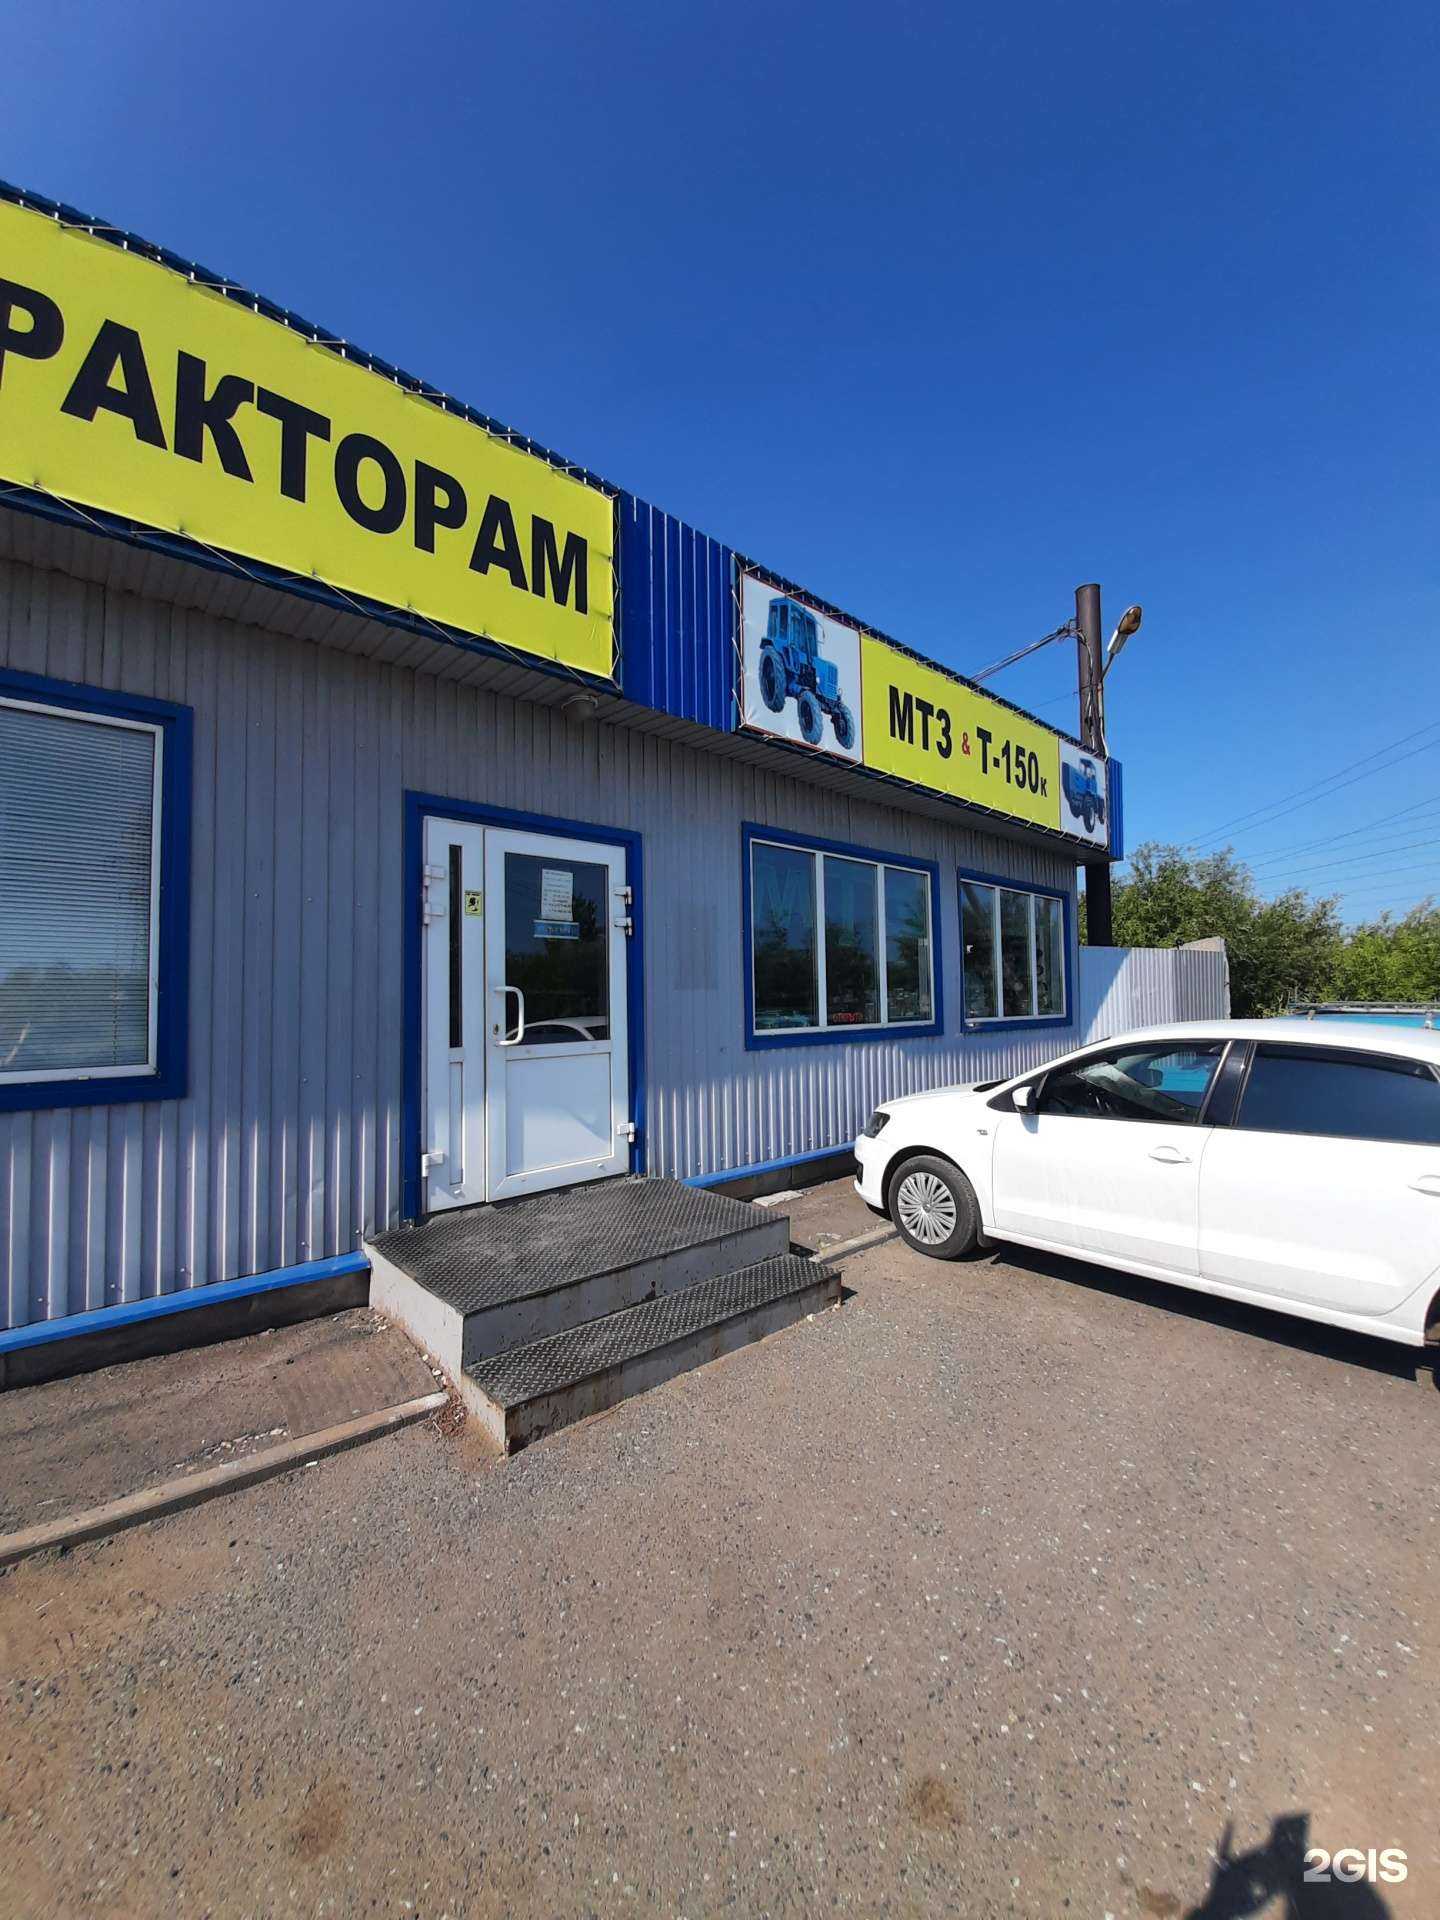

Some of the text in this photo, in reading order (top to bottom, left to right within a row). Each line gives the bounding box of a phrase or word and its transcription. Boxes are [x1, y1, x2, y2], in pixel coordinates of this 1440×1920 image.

[0, 278, 588, 615] РАКТОРАМ
[889, 684, 952, 759] МТЗ
[961, 731, 971, 756] &
